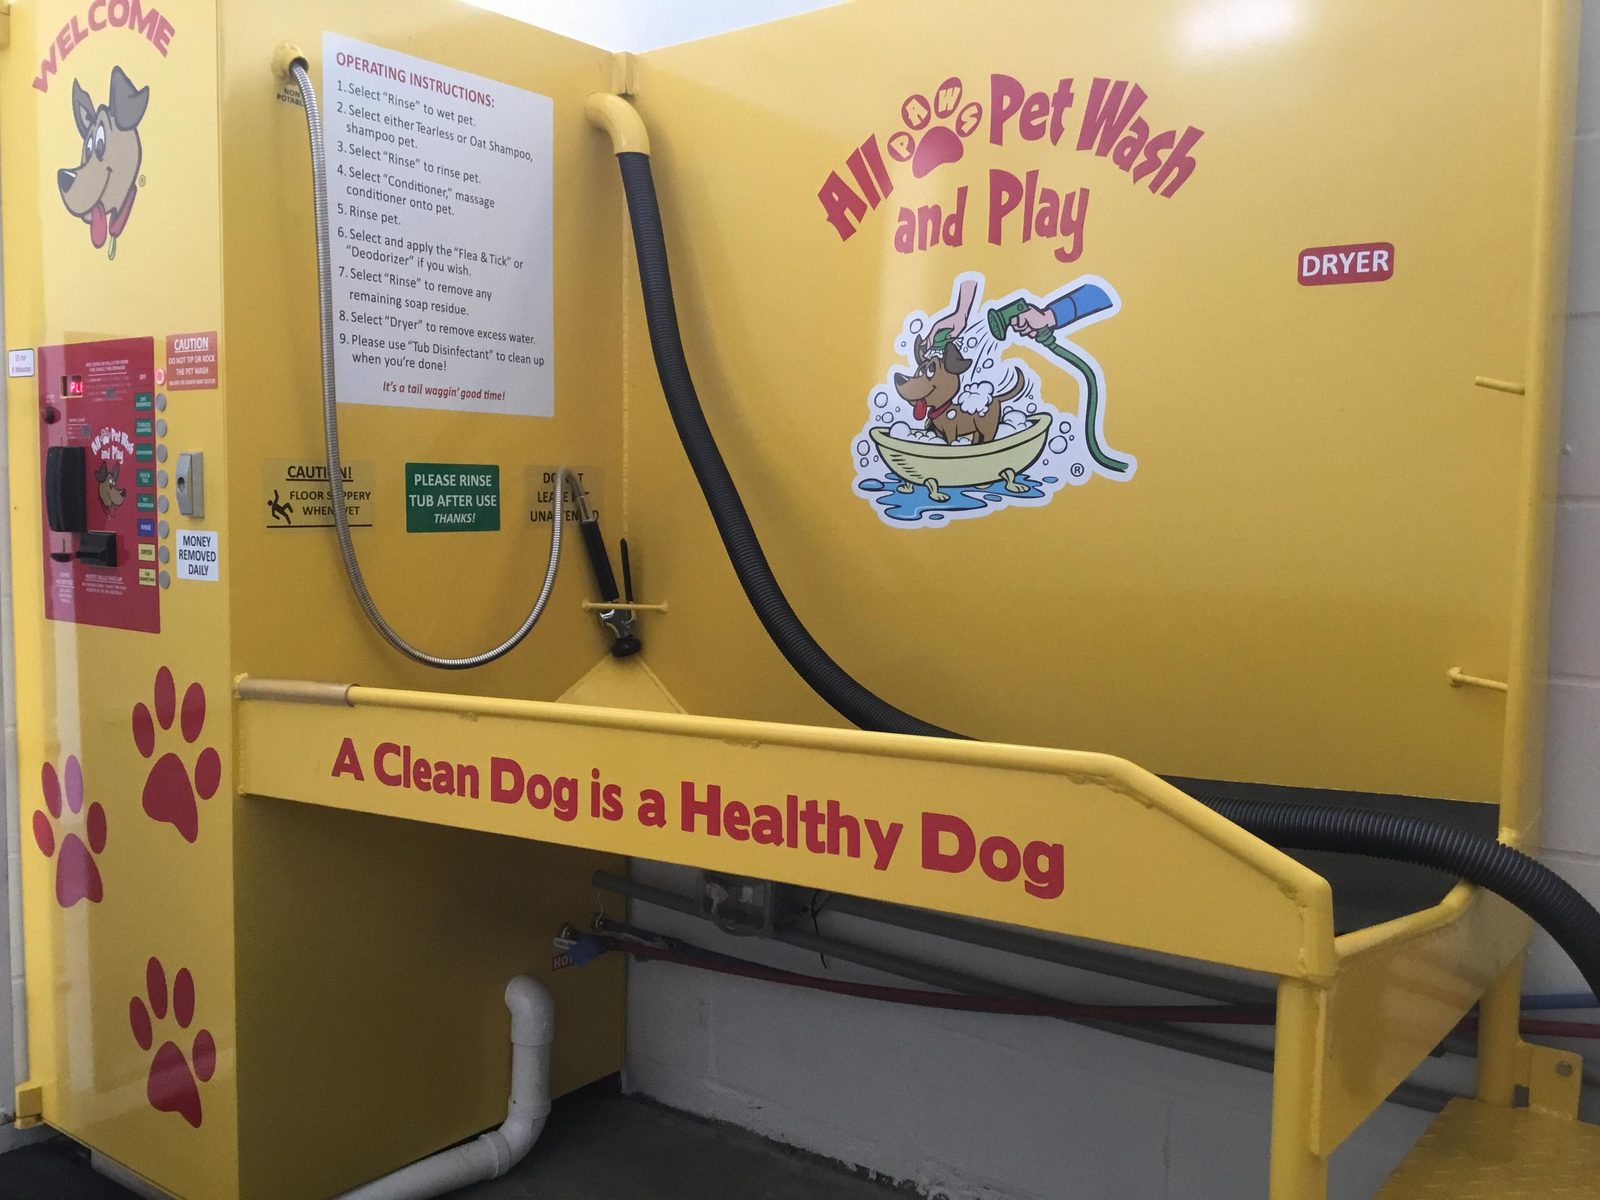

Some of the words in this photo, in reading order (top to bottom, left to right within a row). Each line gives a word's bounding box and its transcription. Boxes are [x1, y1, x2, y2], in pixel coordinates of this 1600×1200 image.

[32, 0, 176, 93] WELCOME
[337, 52, 406, 82] OPERATING
[410, 72, 494, 108] INSTRUCTIONS:
[349, 84, 380, 100] Select
[424, 104, 434, 115] to
[437, 108, 454, 121] wet
[458, 113, 476, 126] pet.
[347, 123, 394, 143] shampoo
[398, 136, 418, 149] pet.
[349, 105, 381, 122] Select
[384, 115, 414, 130] either
[416, 121, 454, 140] Tearless
[457, 134, 467, 143] or
[470, 136, 486, 149] Oat
[489, 141, 533, 162] Shampoo,
[349, 144, 381, 161] Select
[424, 162, 434, 173] to
[437, 166, 460, 179] rinse
[463, 172, 481, 185] pet.
[817, 133, 894, 242] All
[990, 74, 1074, 146] Pet
[1076, 76, 1205, 199] Wash
[347, 185, 406, 205] conditioner
[410, 200, 432, 211] onto
[436, 204, 455, 216] pet.
[349, 167, 381, 184] Select
[456, 190, 495, 209] massage
[350, 206, 378, 220] Rinse
[382, 212, 400, 226] pet.
[894, 185, 968, 254] and
[988, 169, 1090, 264] Play
[350, 229, 381, 246] Select
[385, 235, 403, 248] and
[406, 241, 433, 255] apply
[436, 245, 452, 257] the
[481, 253, 488, 263] &
[514, 259, 523, 269] or
[417, 257, 424, 268] if
[426, 261, 444, 272] you
[447, 263, 472, 276] wish.
[1302, 250, 1389, 278] DRYER
[351, 269, 382, 283] Select
[425, 280, 434, 291] to
[438, 283, 473, 296] remove
[476, 290, 492, 302] any
[350, 290, 401, 308] remaining
[405, 299, 428, 311] soap
[431, 300, 469, 316] residue.
[351, 312, 382, 325] Select
[426, 322, 436, 332] to
[439, 325, 474, 337] remove
[477, 329, 506, 341] excess
[509, 334, 536, 344] water.
[174, 337, 208, 350] CAUTION
[352, 335, 385, 348] Please
[388, 341, 406, 350] use
[496, 352, 506, 361] to
[508, 354, 531, 365] clean
[533, 357, 545, 367] up
[352, 352, 381, 365] when
[418, 358, 446, 371] done!
[408, 384, 422, 394] tail
[461, 389, 482, 399] good
[484, 390, 505, 401] time!
[287, 466, 352, 479] CAUTIN!
[414, 474, 456, 487] PLEASE
[460, 474, 492, 487] RINSE
[290, 491, 324, 500] FLOOR
[409, 494, 434, 507] TUB
[438, 494, 474, 507] AFTER
[476, 494, 497, 507] USE
[537, 492, 568, 502] LEAE
[302, 506, 335, 515] WHEN
[434, 513, 476, 524] THANKS!
[183, 535, 211, 548] MONEY
[178, 549, 216, 562] REMOVED
[188, 563, 209, 576] DAILY
[331, 737, 365, 782] A
[373, 742, 480, 800] Clean
[490, 756, 578, 822] Dog
[590, 768, 624, 820] is
[638, 788, 666, 828] a
[680, 780, 904, 871] Healthy
[920, 812, 1064, 900] Dog
